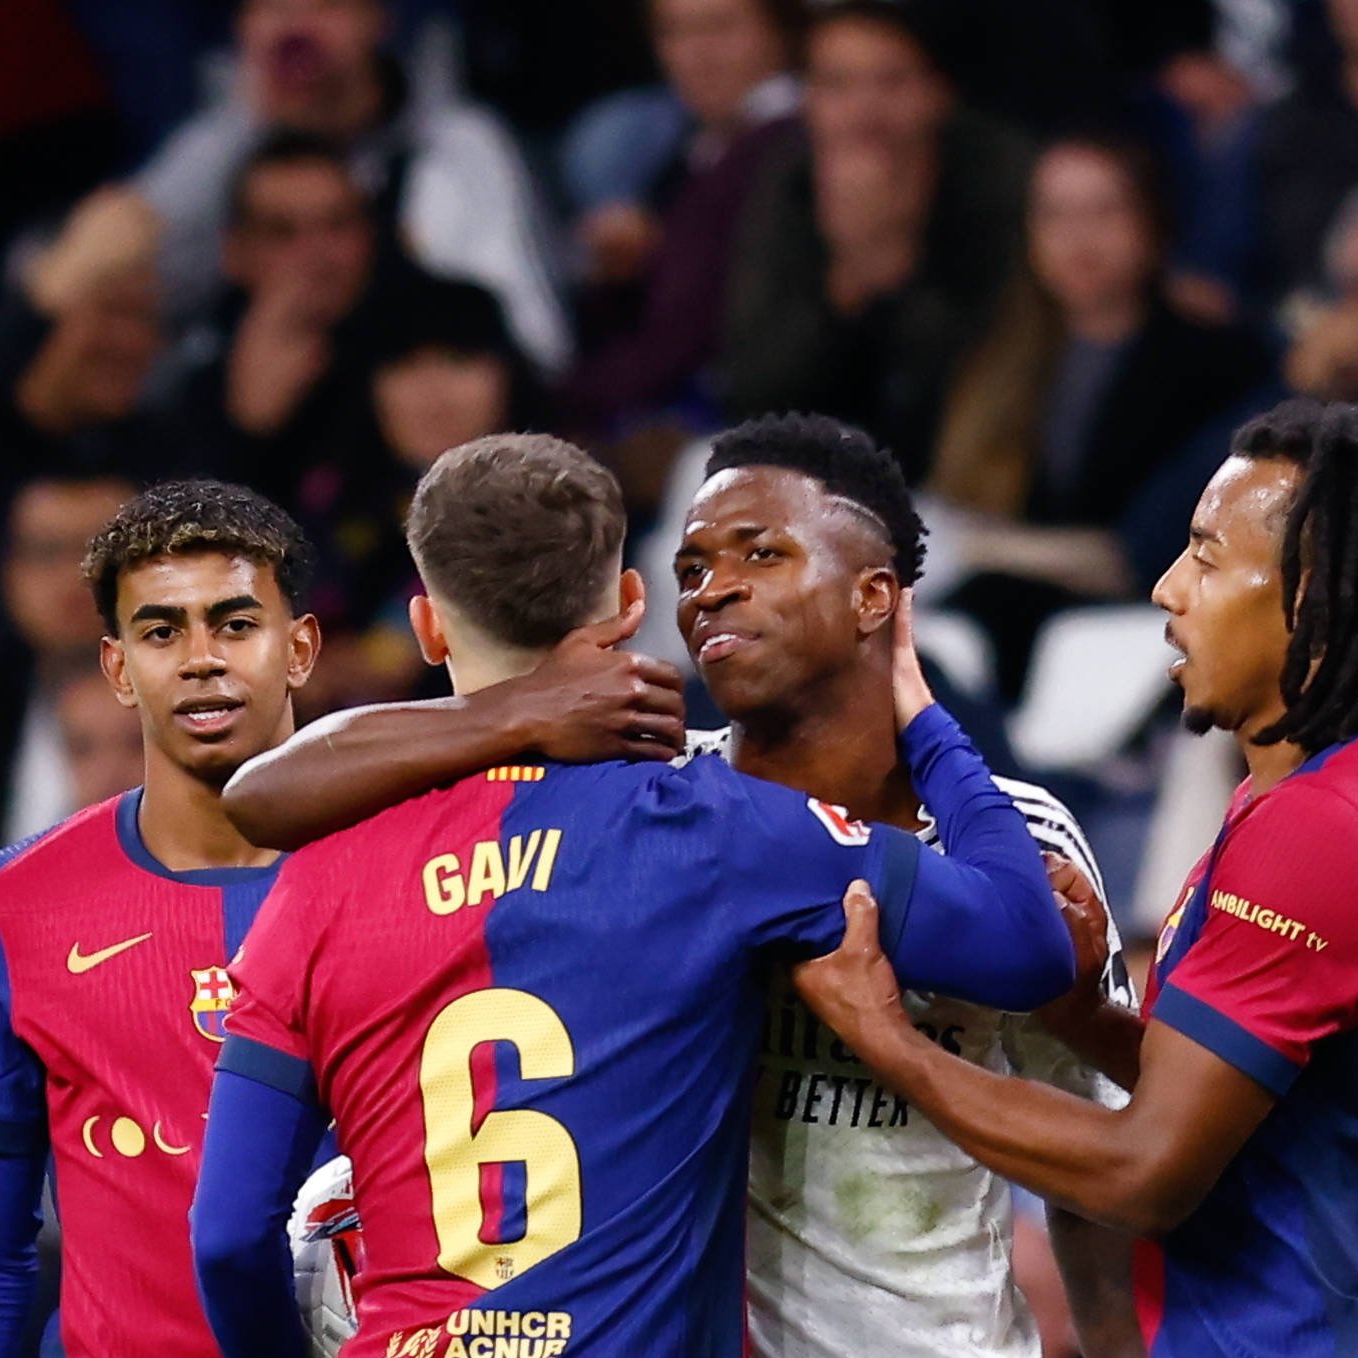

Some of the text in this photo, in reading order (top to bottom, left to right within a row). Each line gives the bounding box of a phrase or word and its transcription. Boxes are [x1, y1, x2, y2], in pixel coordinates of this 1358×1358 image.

[421, 828, 562, 916] GAVI
[1210, 888, 1329, 952] AMBILIGHT tv
[418, 987, 583, 1292] 6
[445, 1308, 572, 1339] UNHCR
